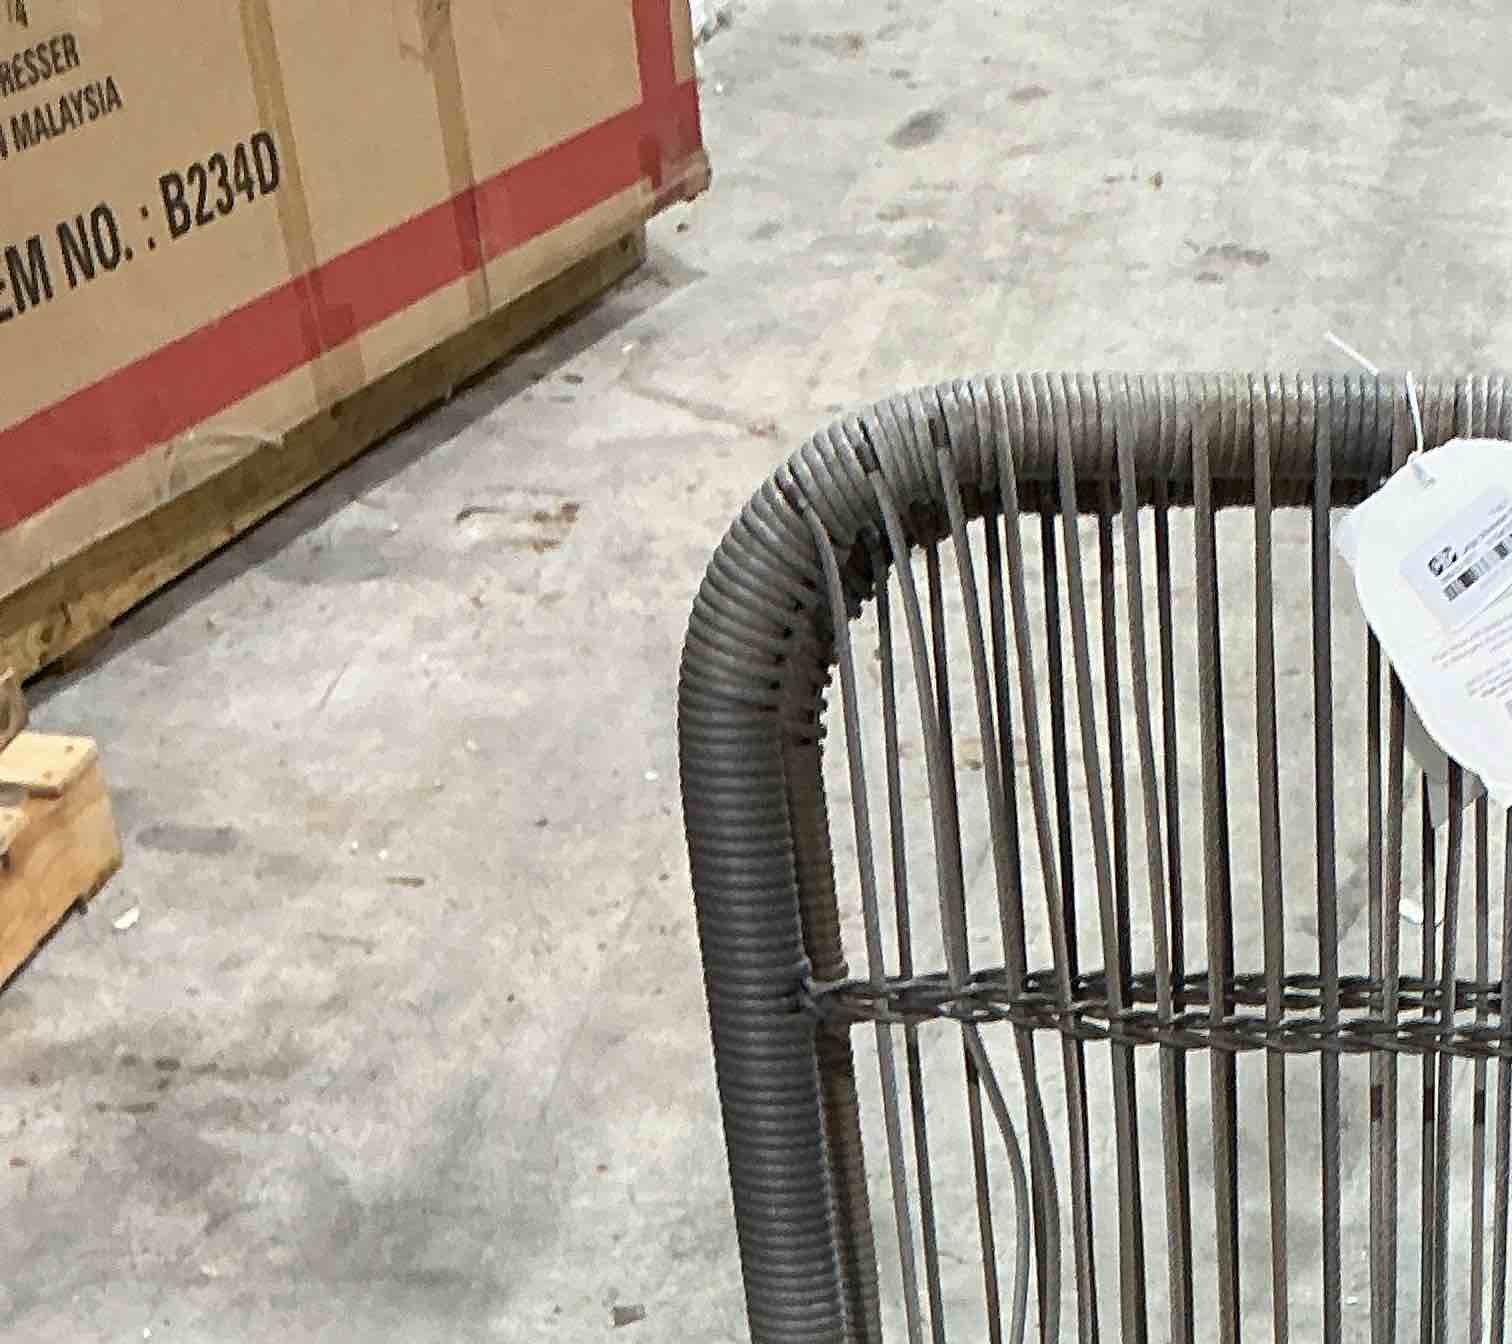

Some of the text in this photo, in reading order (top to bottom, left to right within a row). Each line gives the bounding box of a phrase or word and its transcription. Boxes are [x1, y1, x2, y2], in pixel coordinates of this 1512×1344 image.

[0, 31, 80, 97] RESSER
[10, 75, 122, 152] MALAYSIA
[159, 131, 280, 240] B234D
